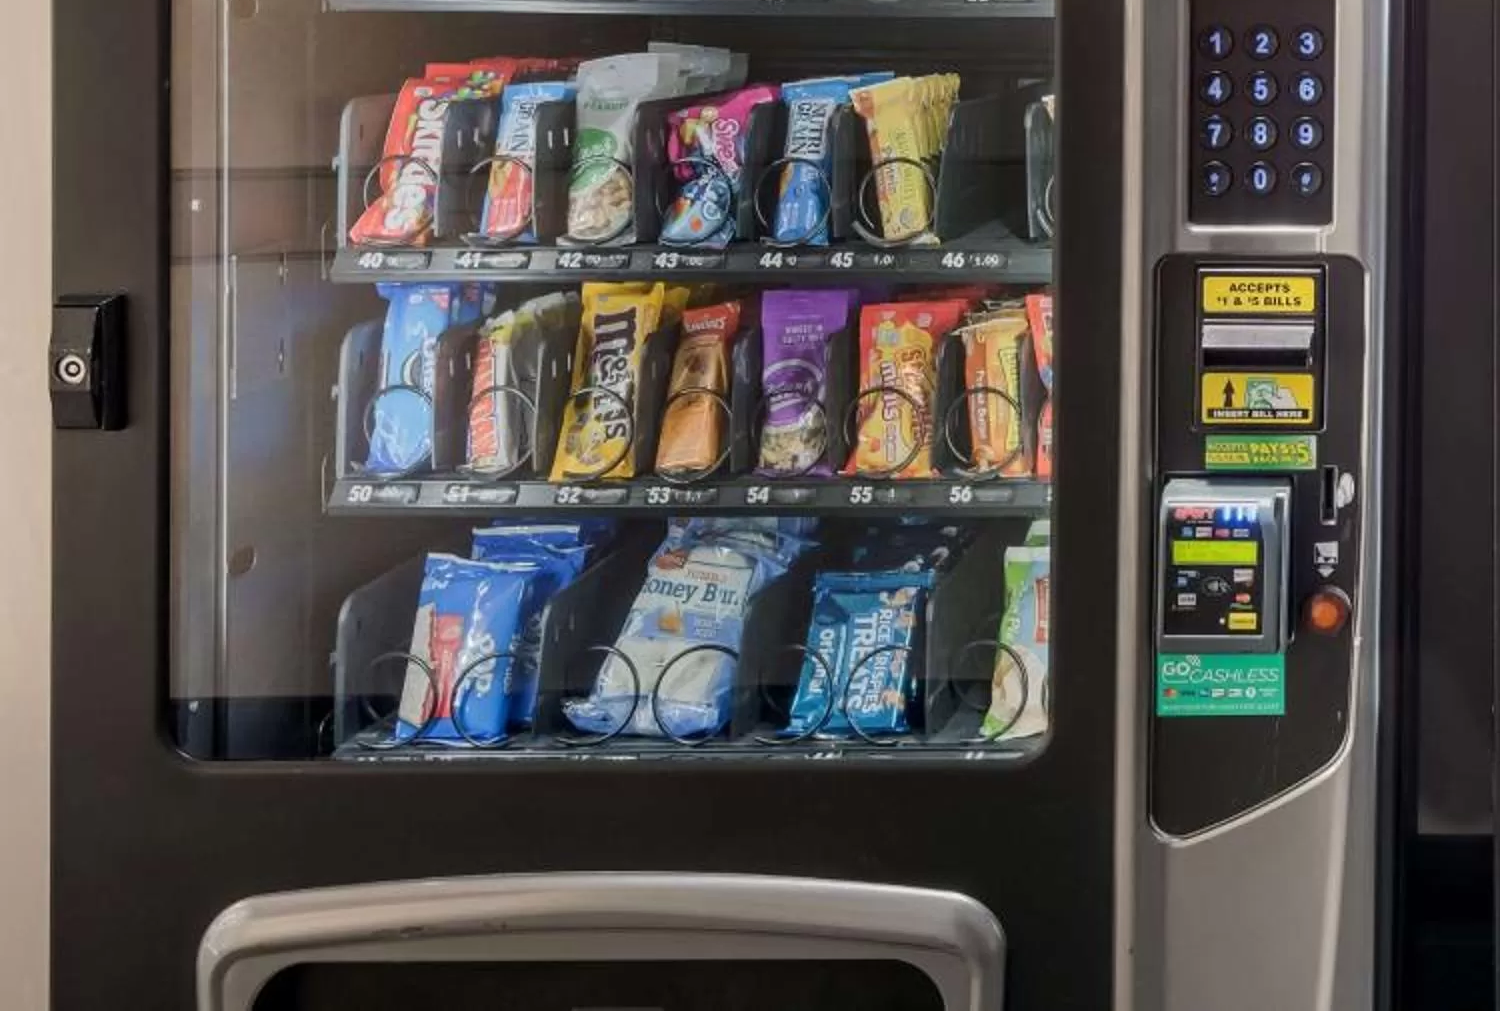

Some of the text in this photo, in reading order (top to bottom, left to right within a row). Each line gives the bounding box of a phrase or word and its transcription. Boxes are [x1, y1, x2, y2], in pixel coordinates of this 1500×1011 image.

[1210, 32, 1221, 54] 1
[1255, 32, 1269, 54] 2
[1299, 32, 1315, 54] 3
[1207, 77, 1222, 99] 4
[1254, 78, 1269, 100] 5
[1299, 78, 1315, 101] 6
[809, 101, 828, 156] NUTRI
[1207, 124, 1222, 146] 7
[1254, 123, 1268, 144] 8
[1298, 123, 1313, 145] 9
[1253, 168, 1267, 189] 0
[358, 252, 384, 268] 40
[457, 252, 480, 268] 41
[558, 252, 582, 268] 42
[655, 252, 678, 268] 43
[759, 252, 783, 267] 44
[830, 252, 854, 267] 45
[941, 252, 965, 268] 46
[1228, 282, 1291, 294] ACCEPTS
[1233, 297, 1243, 307] &
[1263, 296, 1302, 307] BILLS
[1250, 409, 1274, 418] BILL
[557, 487, 580, 503] 52
[648, 487, 670, 503] 53
[747, 487, 769, 503] 54
[850, 487, 873, 503] 55
[950, 487, 972, 502] 56
[877, 607, 895, 641] RICE
[845, 612, 878, 711] TREATS
[1162, 661, 1280, 684] GO CASHLESS
